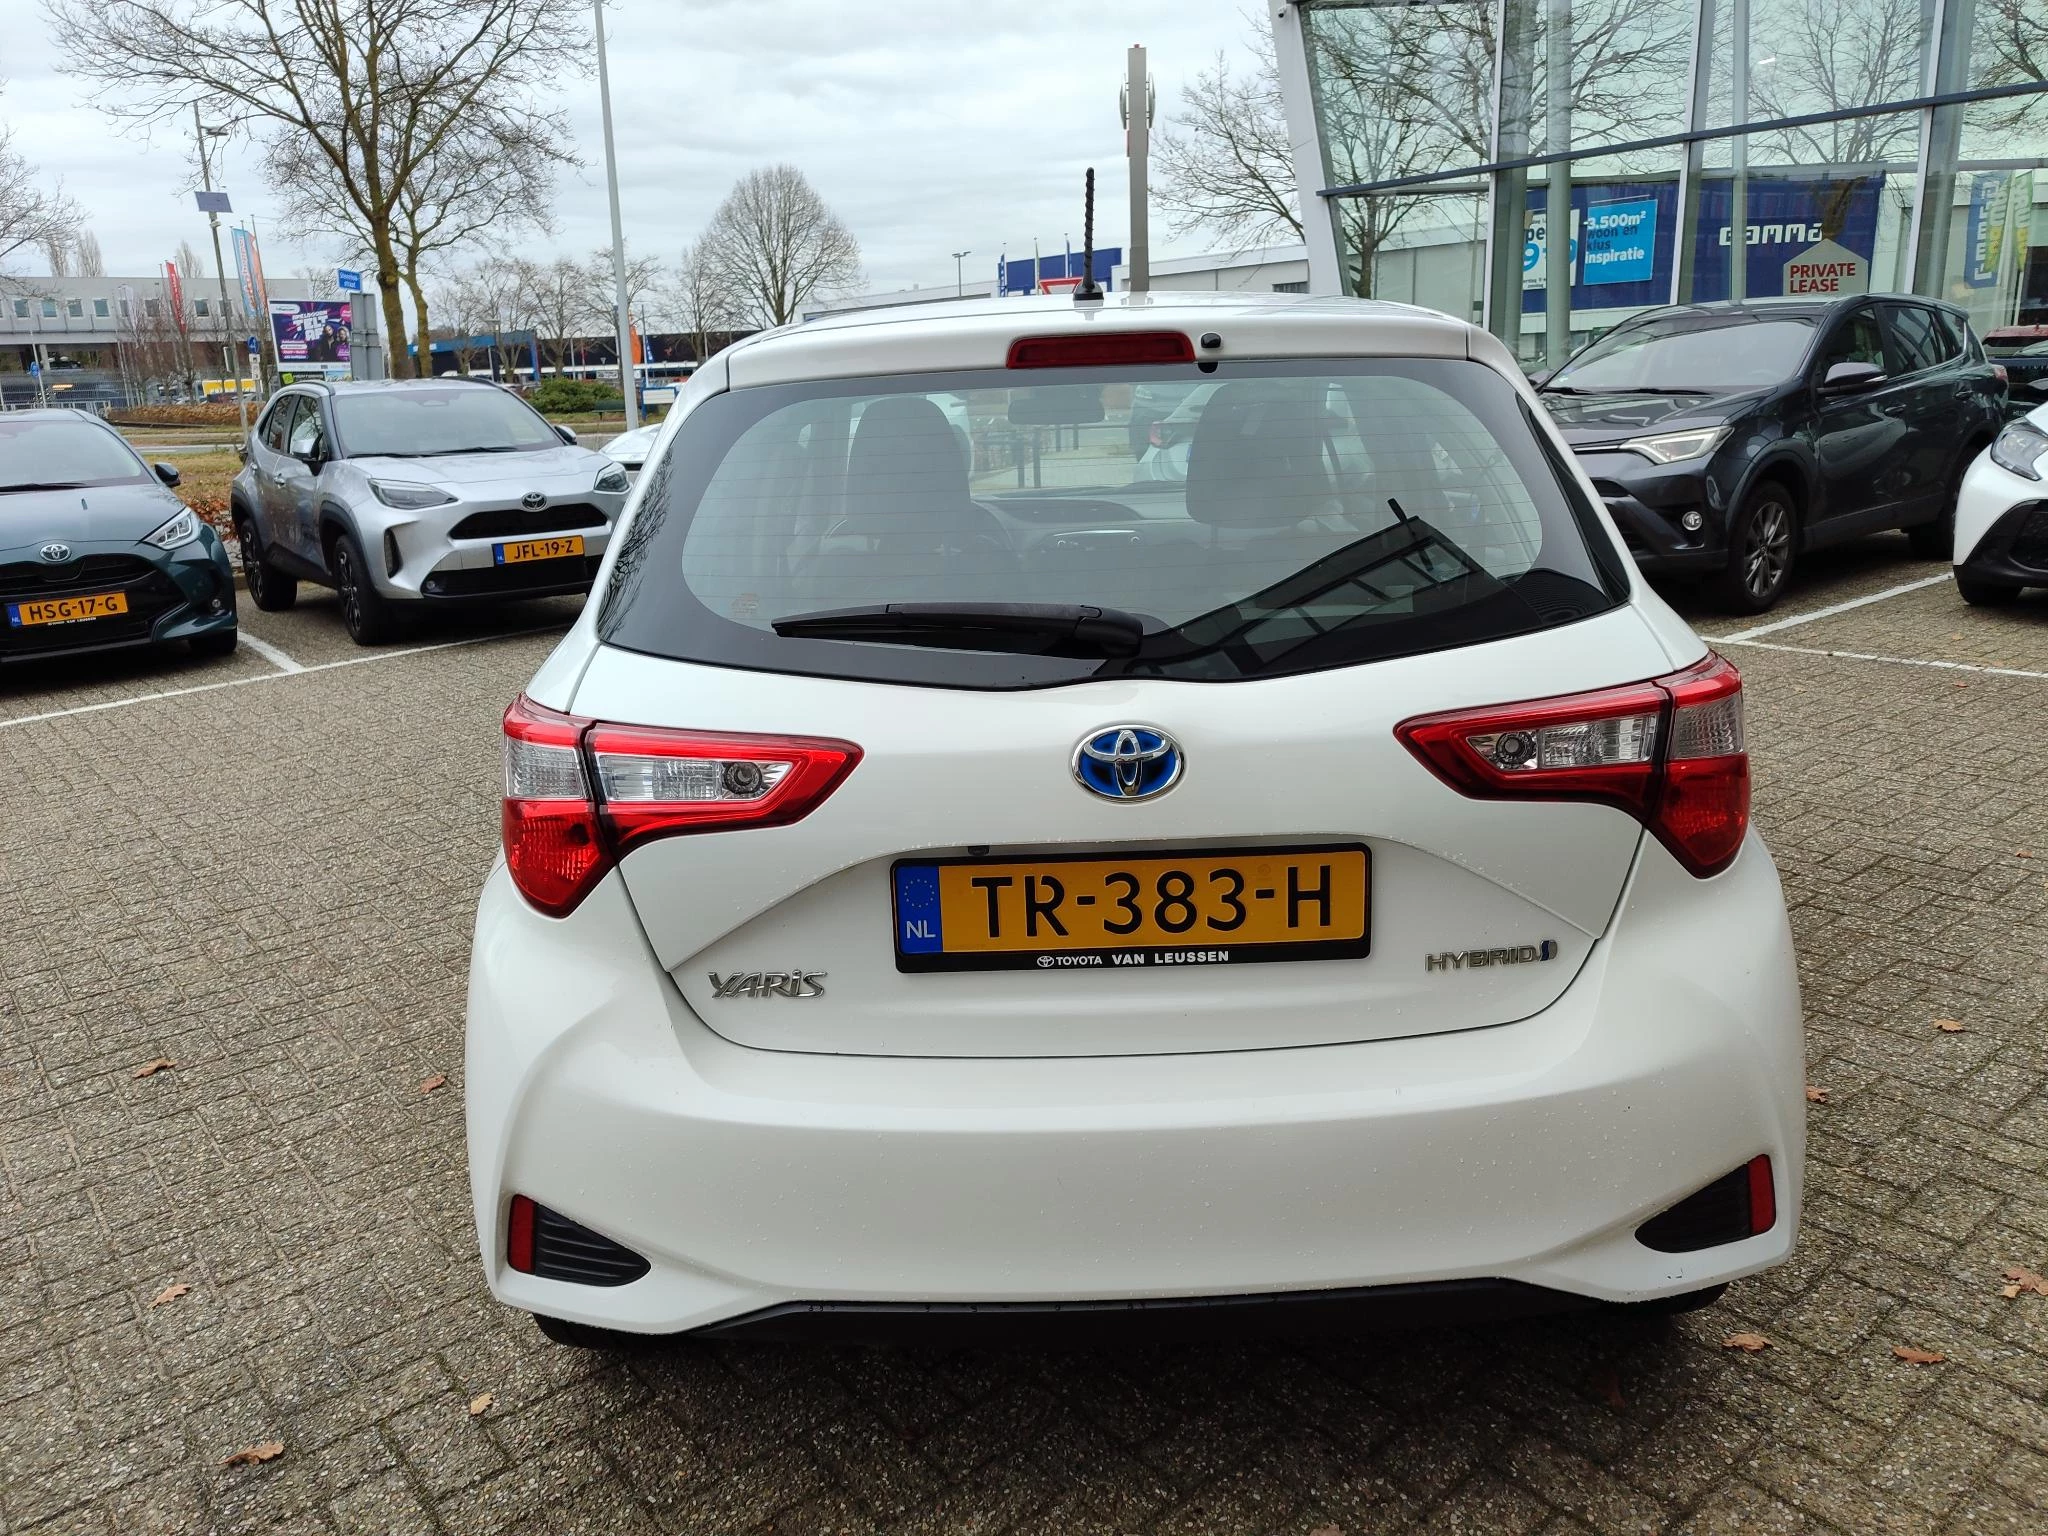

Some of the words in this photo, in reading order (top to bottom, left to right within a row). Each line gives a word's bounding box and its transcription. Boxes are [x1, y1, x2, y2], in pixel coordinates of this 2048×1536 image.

[1623, 225, 1638, 236] en
[1585, 246, 1645, 265] inspiratie
[1790, 263, 1856, 279] PRIVATE
[1790, 278, 1840, 294] LEASE
[514, 539, 574, 560] JFL-19-Z
[29, 596, 118, 621] HSG-17-G
[906, 919, 937, 939] NL
[971, 865, 1331, 938] TR-383-H
[1056, 955, 1103, 966] TOYOTA
[1112, 953, 1145, 965] VAN
[1154, 951, 1229, 964] LEUSSEN
[1424, 944, 1539, 972] HYBRID
